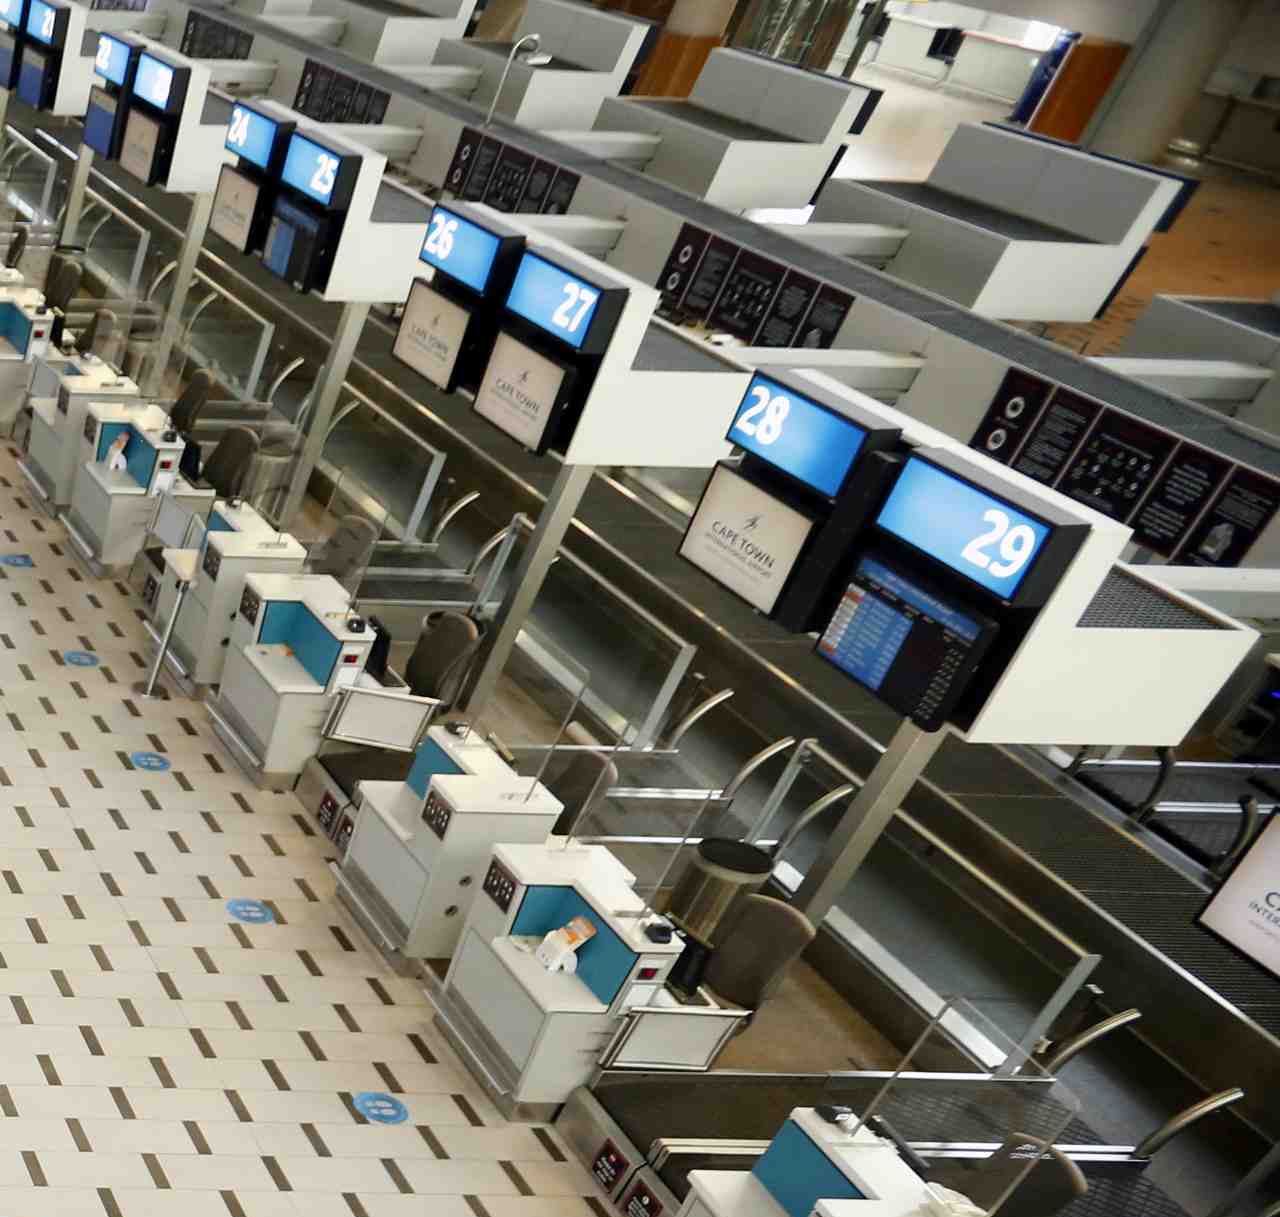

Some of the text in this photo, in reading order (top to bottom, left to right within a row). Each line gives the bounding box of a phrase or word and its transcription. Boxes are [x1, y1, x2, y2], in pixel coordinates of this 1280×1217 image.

[227, 108, 250, 147] 24
[309, 153, 340, 195] 25
[424, 213, 458, 260] 26
[551, 281, 598, 333] 27
[735, 385, 790, 446] 28
[960, 509, 1037, 579] 29
